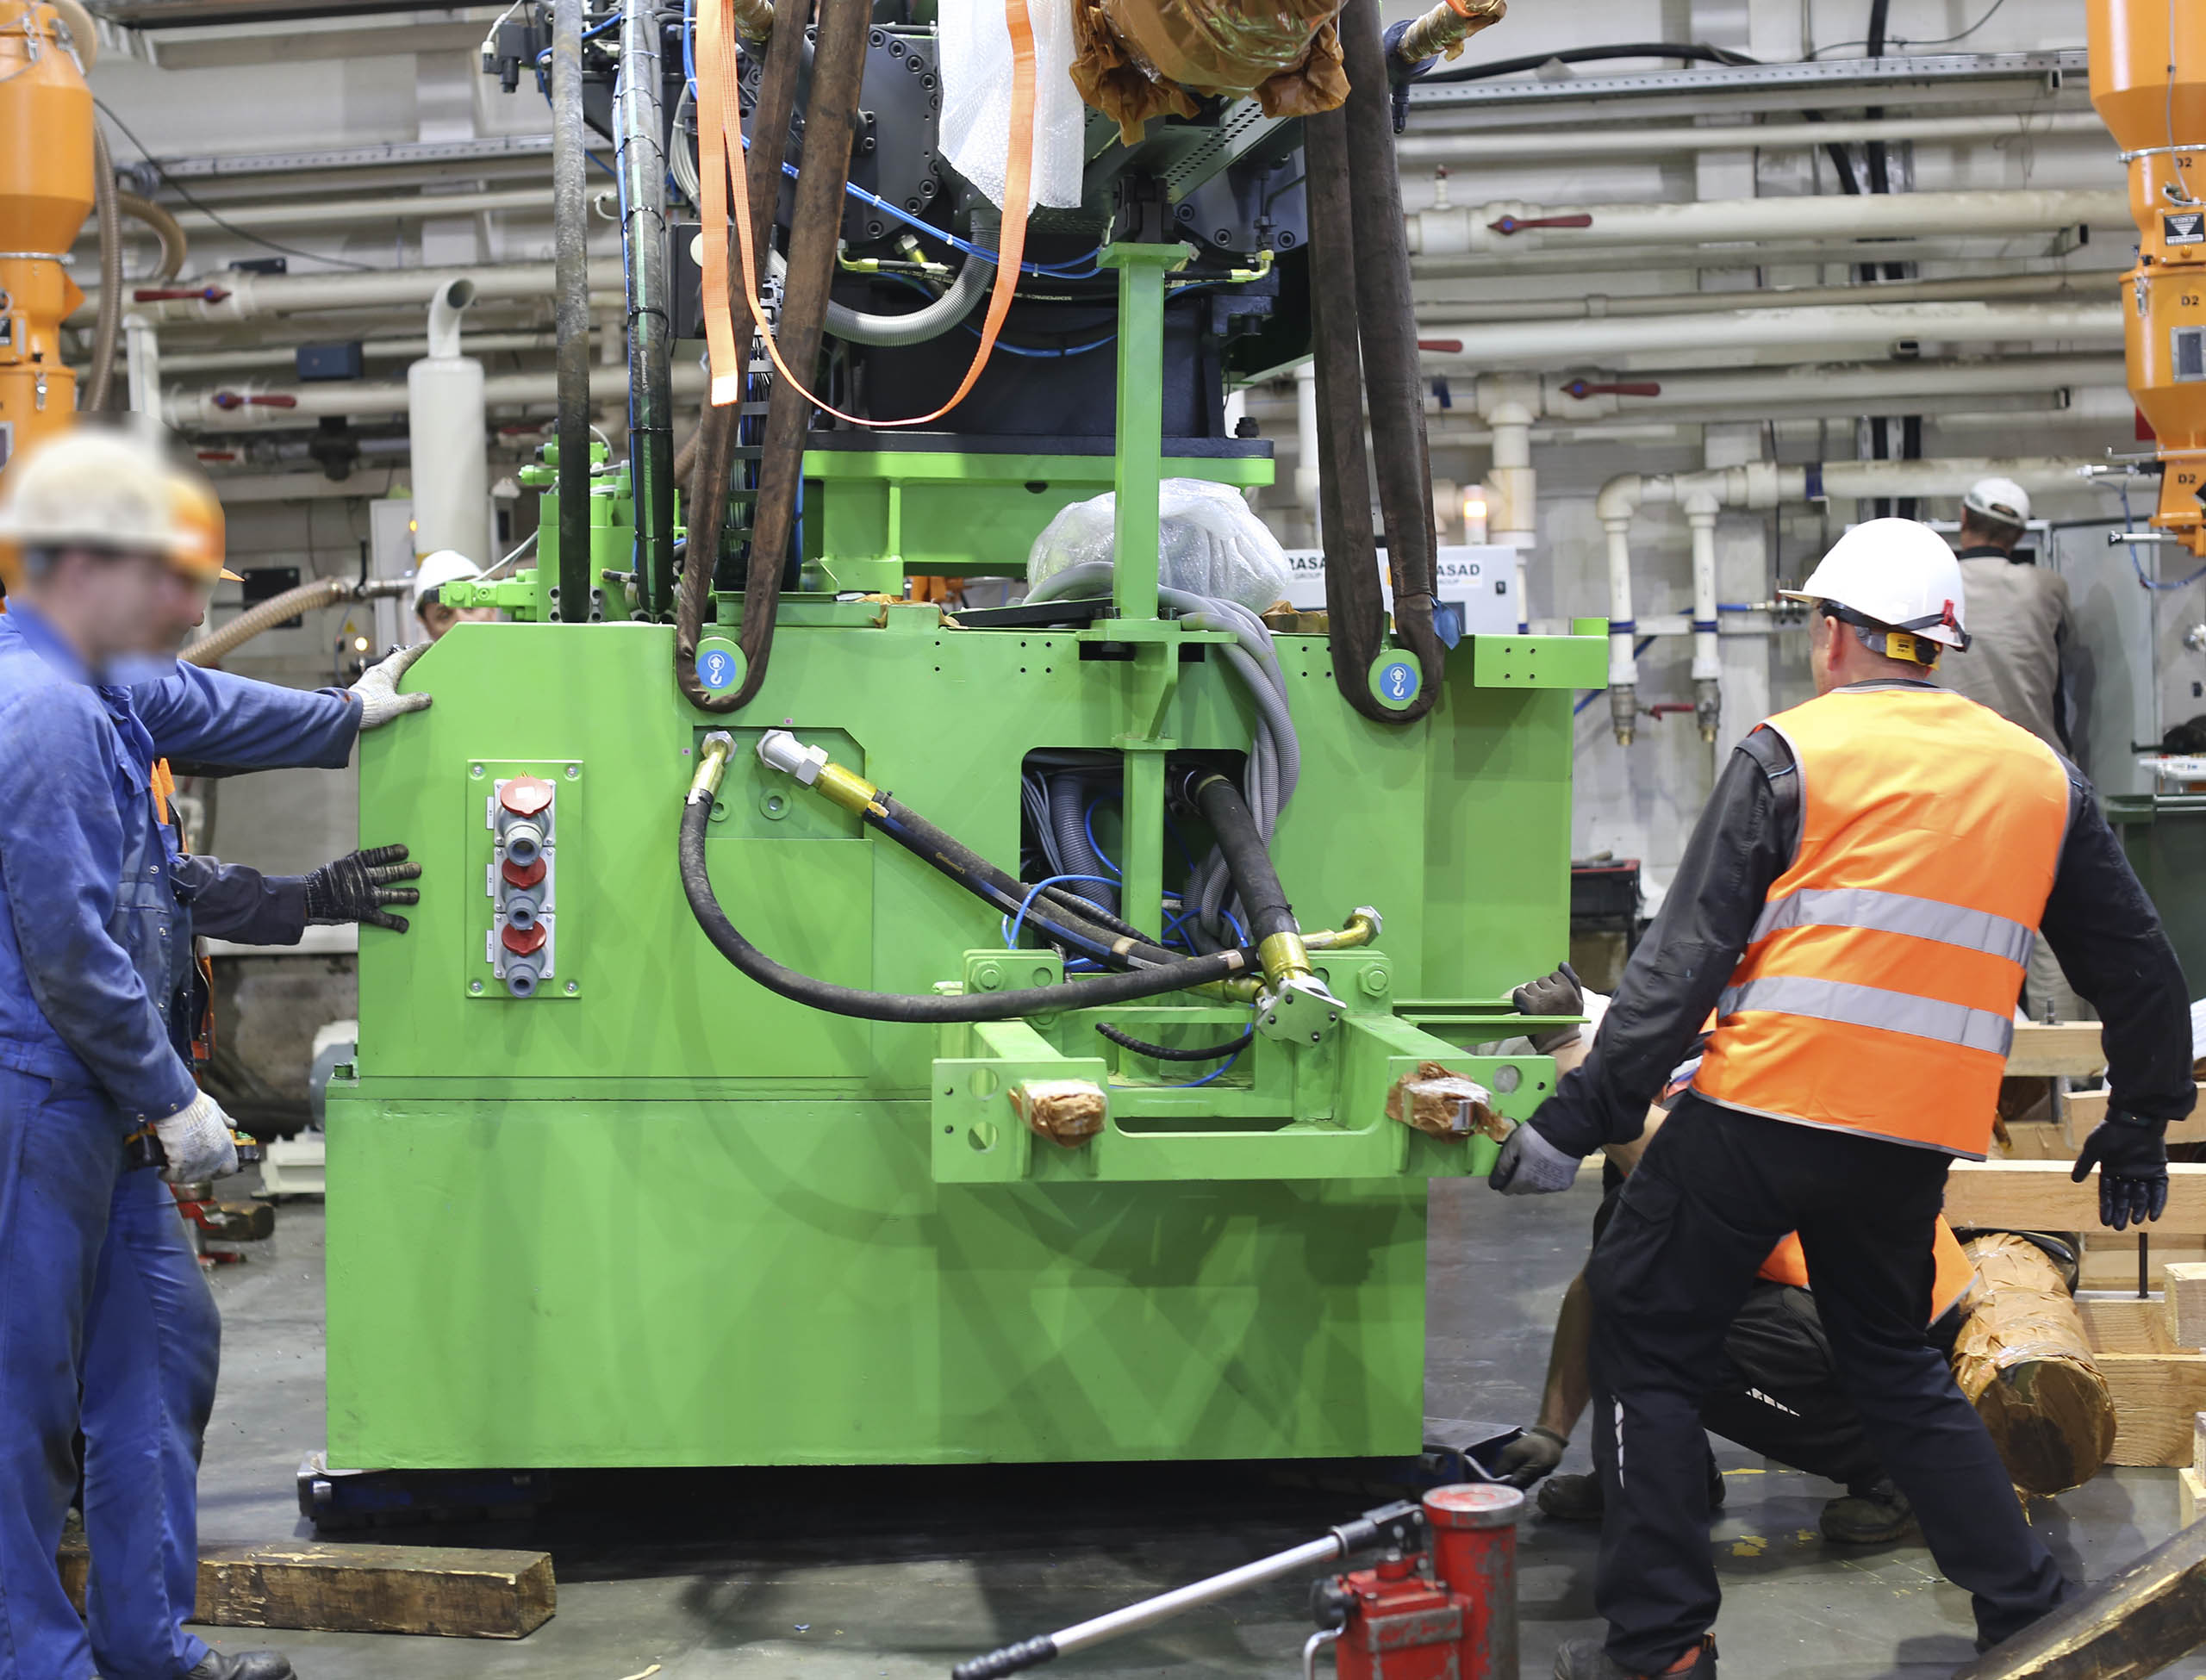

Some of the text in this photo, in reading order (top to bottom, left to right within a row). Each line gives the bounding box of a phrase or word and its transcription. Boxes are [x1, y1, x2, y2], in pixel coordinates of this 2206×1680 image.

[2181, 296, 2200, 306] D2
[2178, 473, 2197, 484] D2
[1289, 557, 1325, 570] RASA
[1436, 563, 1480, 576] ASAD
